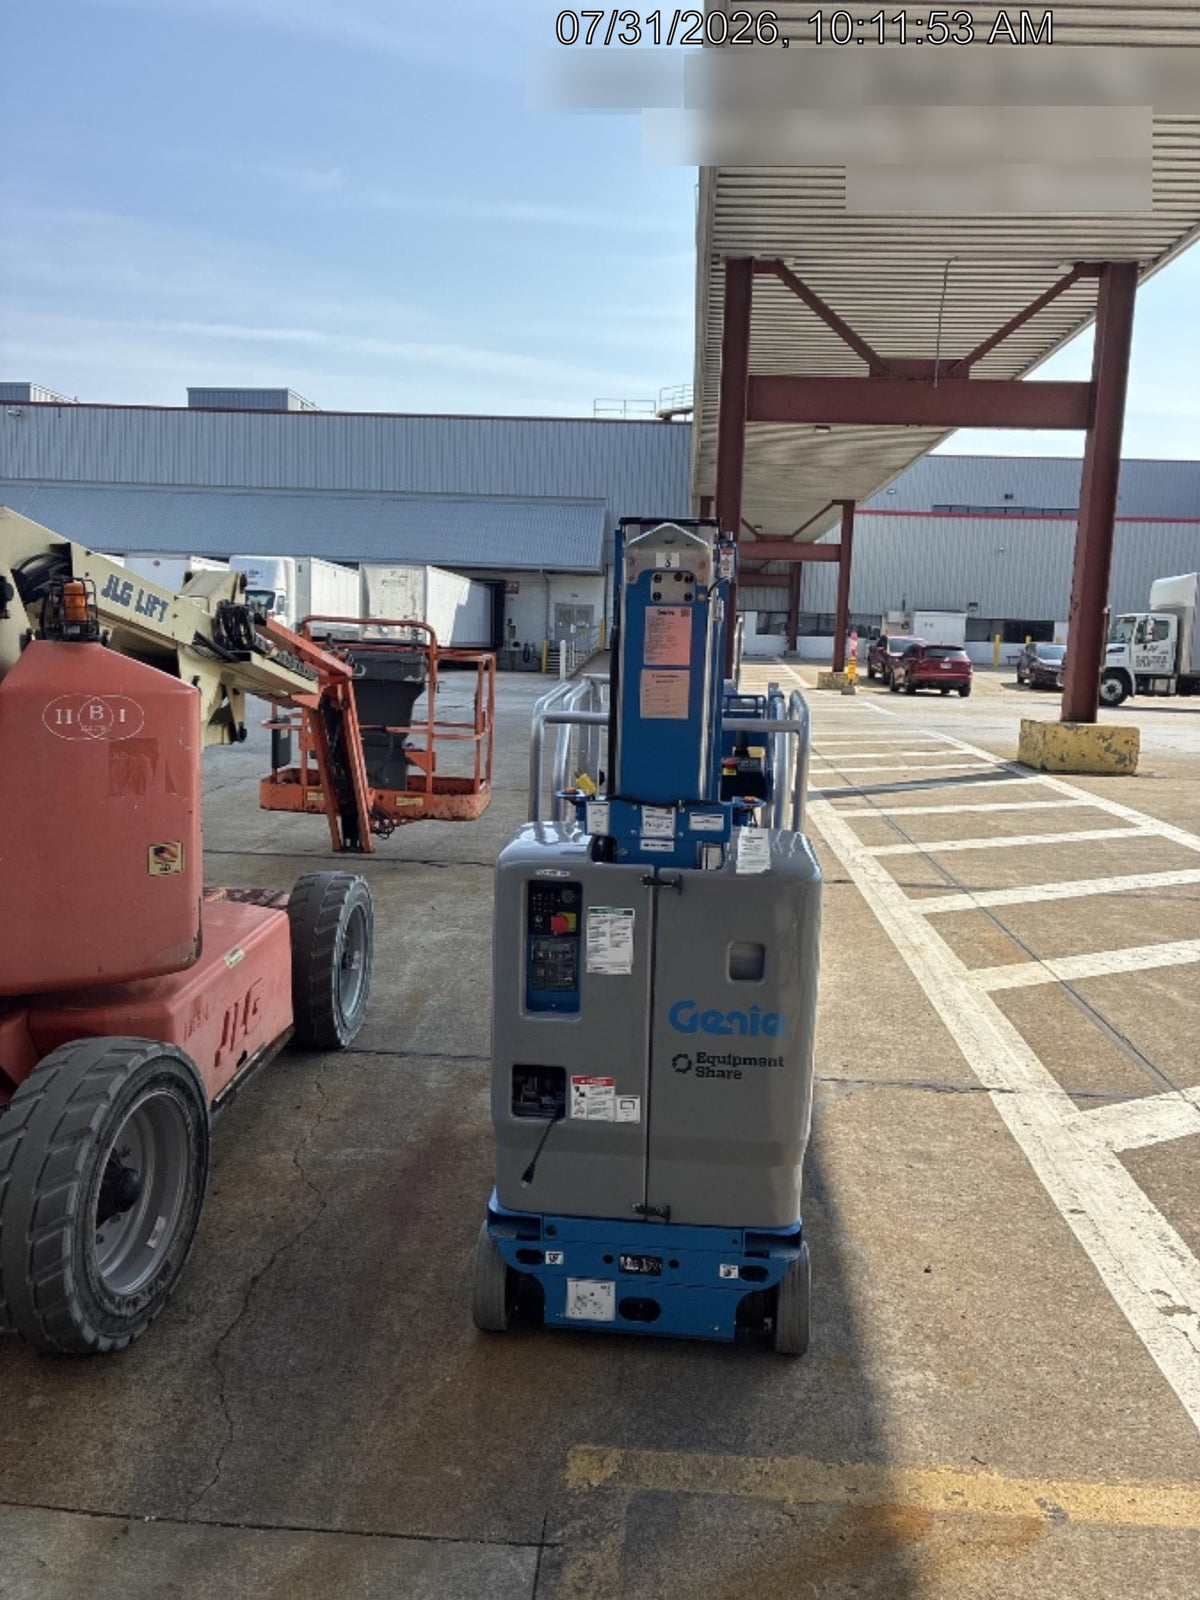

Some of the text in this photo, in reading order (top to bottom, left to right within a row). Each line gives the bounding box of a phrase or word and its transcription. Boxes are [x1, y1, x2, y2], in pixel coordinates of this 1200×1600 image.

[101, 574, 169, 623] JLG LIFT
[669, 999, 784, 1037] Genie
[696, 1051, 785, 1067] Equipment
[695, 1066, 742, 1080] Share
